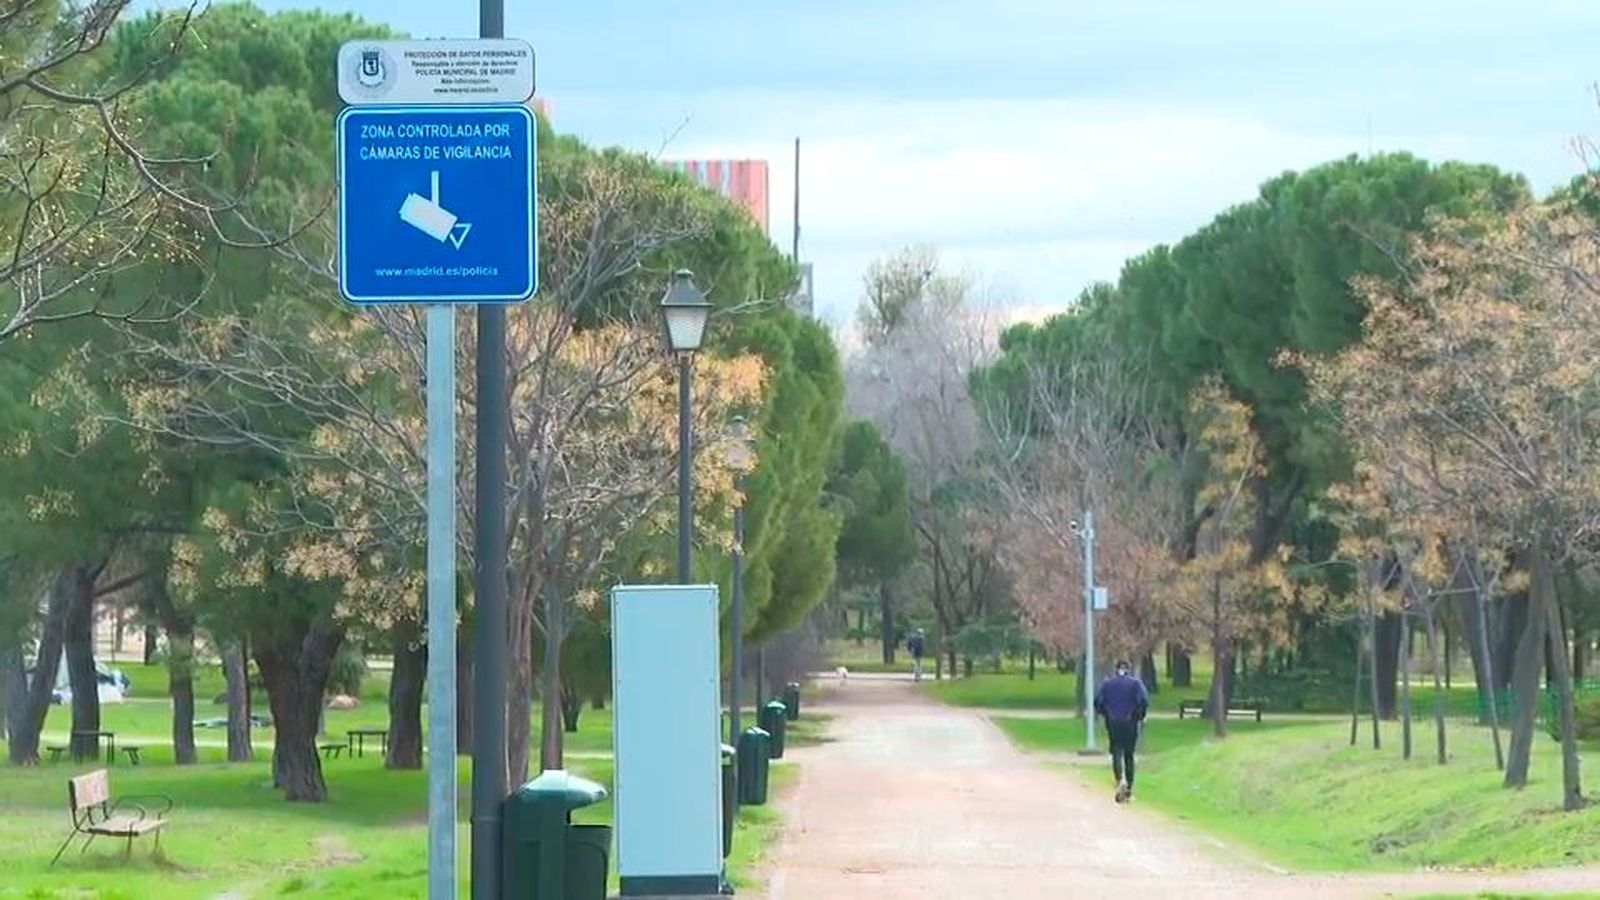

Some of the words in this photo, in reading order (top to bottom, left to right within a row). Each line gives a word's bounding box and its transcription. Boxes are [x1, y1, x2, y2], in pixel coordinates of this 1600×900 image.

[360, 124, 395, 139] ZONA
[397, 124, 482, 138] CONTROLADA
[484, 124, 511, 138] POR
[360, 143, 421, 160] CÁMARAS
[424, 146, 440, 160] DE
[443, 146, 513, 160] VIGILANCIA
